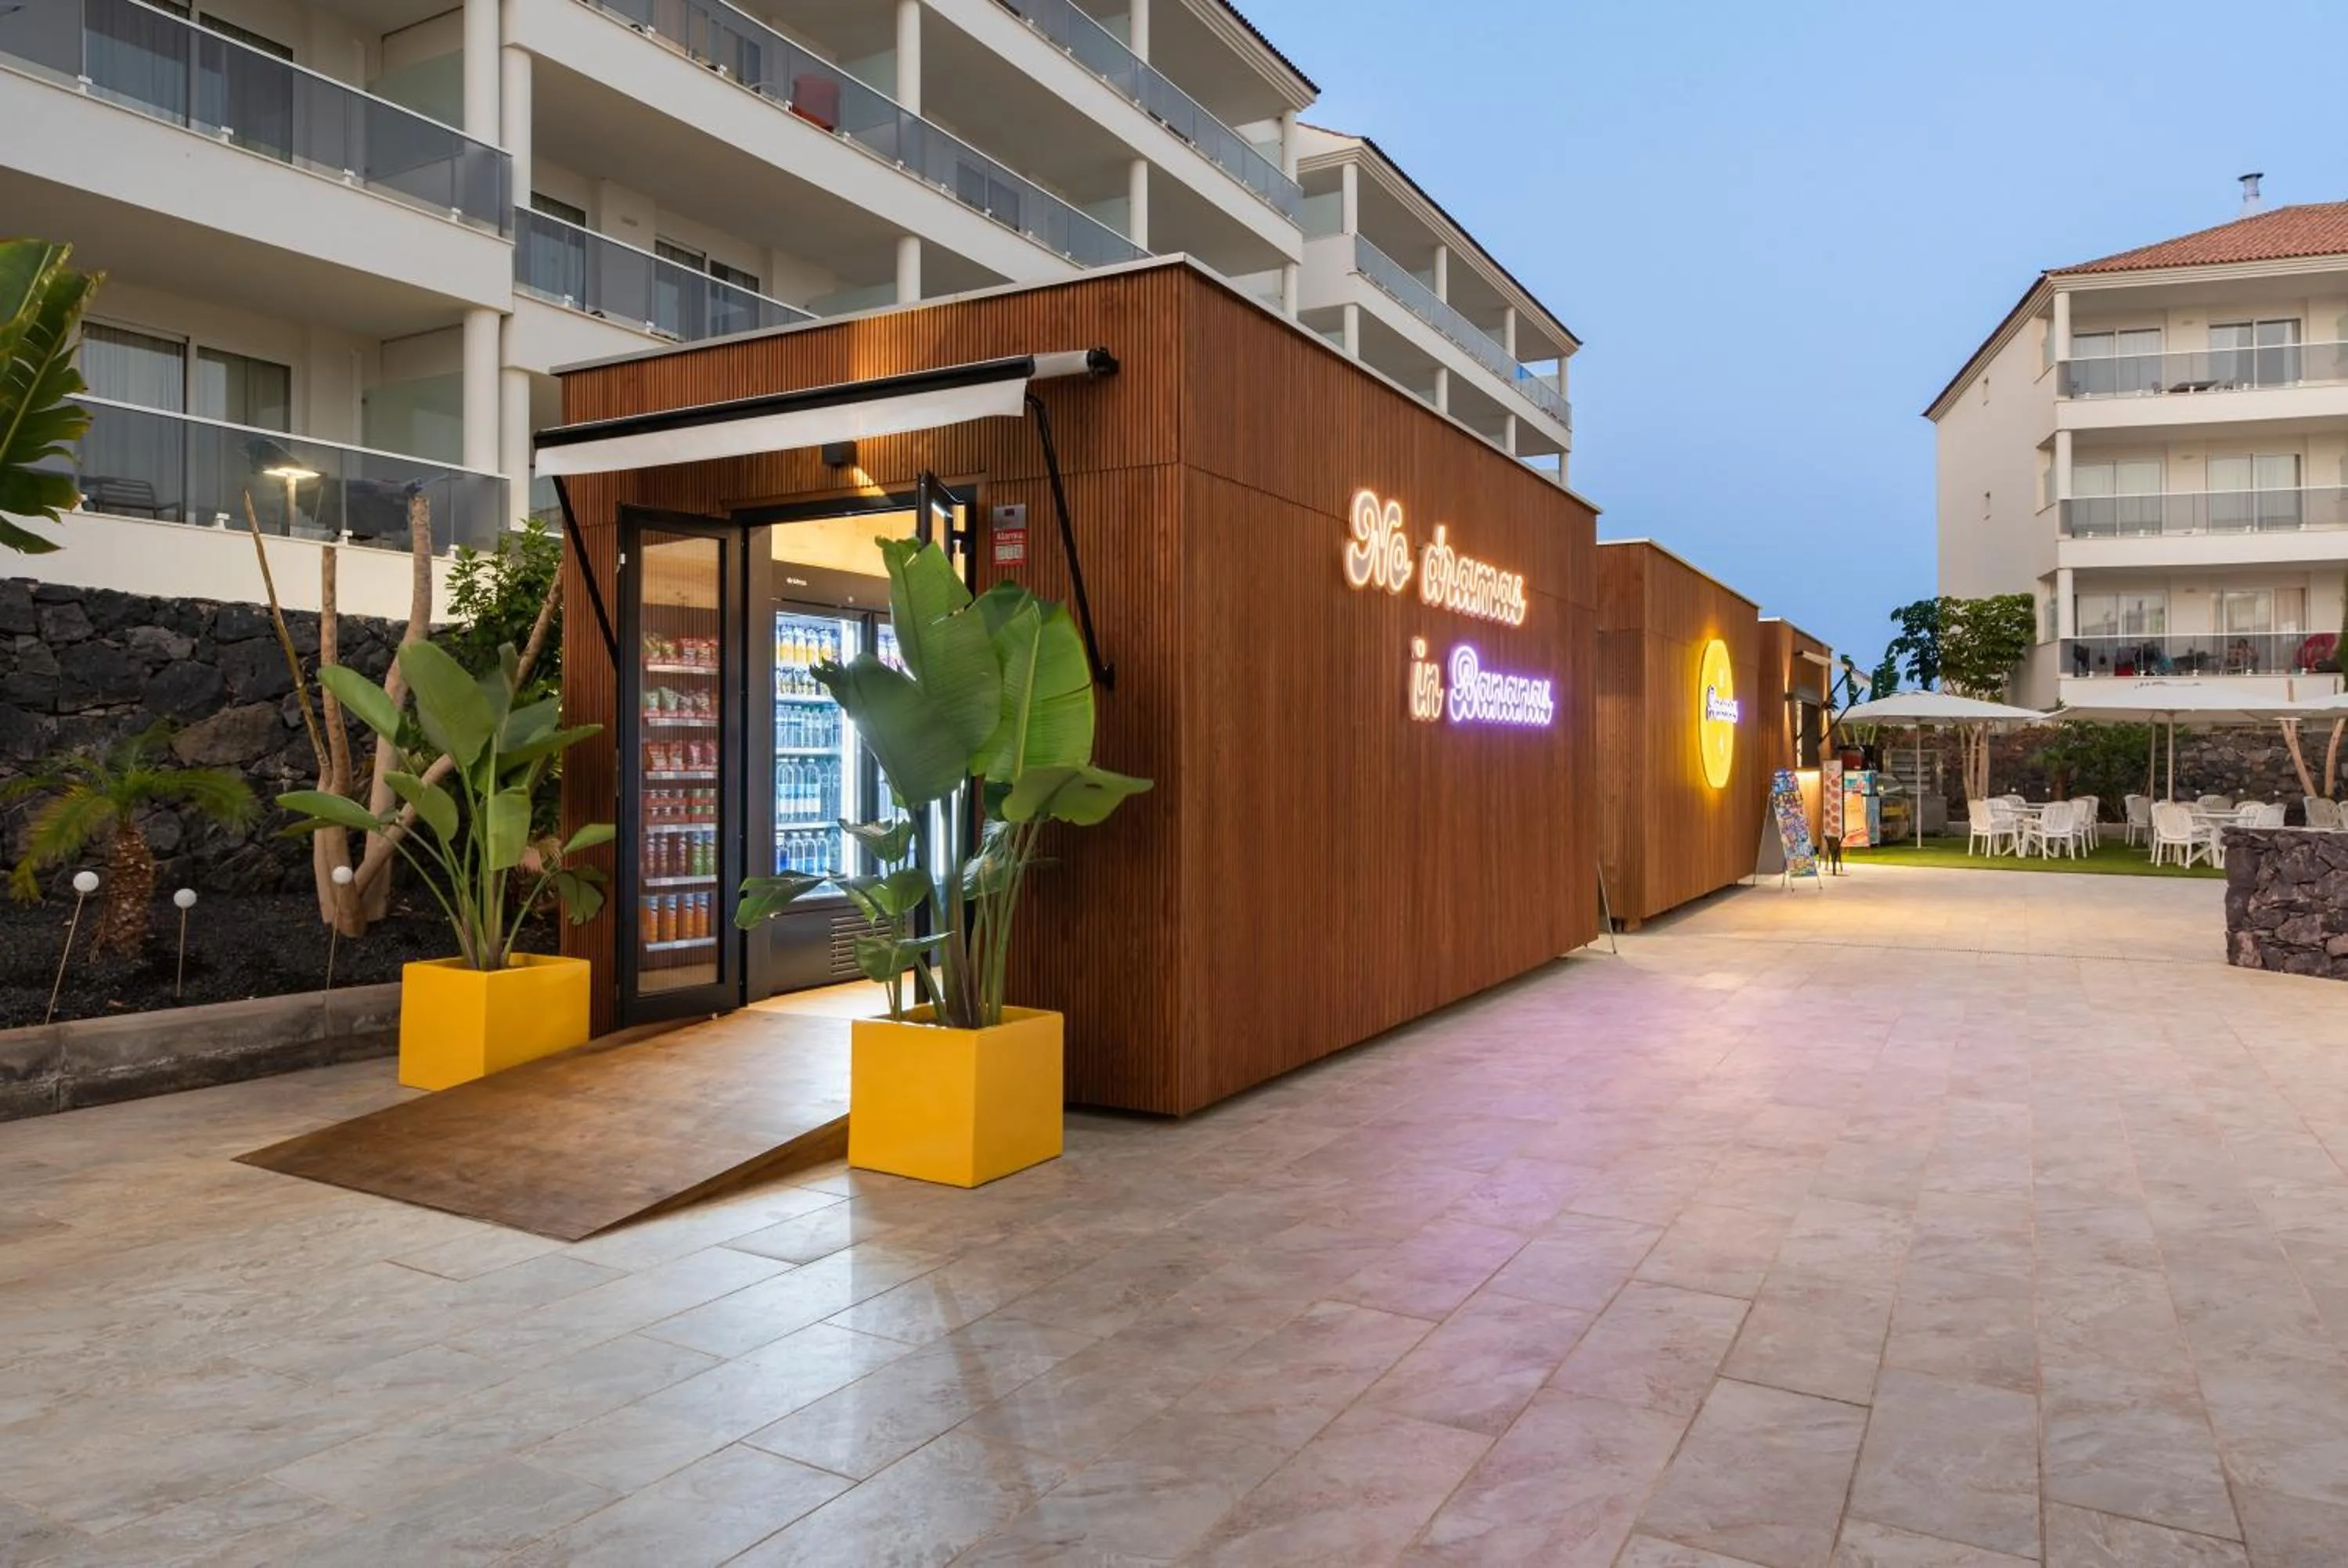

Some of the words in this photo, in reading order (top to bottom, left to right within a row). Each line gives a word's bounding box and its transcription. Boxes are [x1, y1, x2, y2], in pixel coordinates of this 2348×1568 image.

[1346, 490, 1412, 592] No
[1424, 524, 1526, 626] dramas
[1411, 636, 1443, 719] in
[1449, 646, 1553, 725] Bananas
